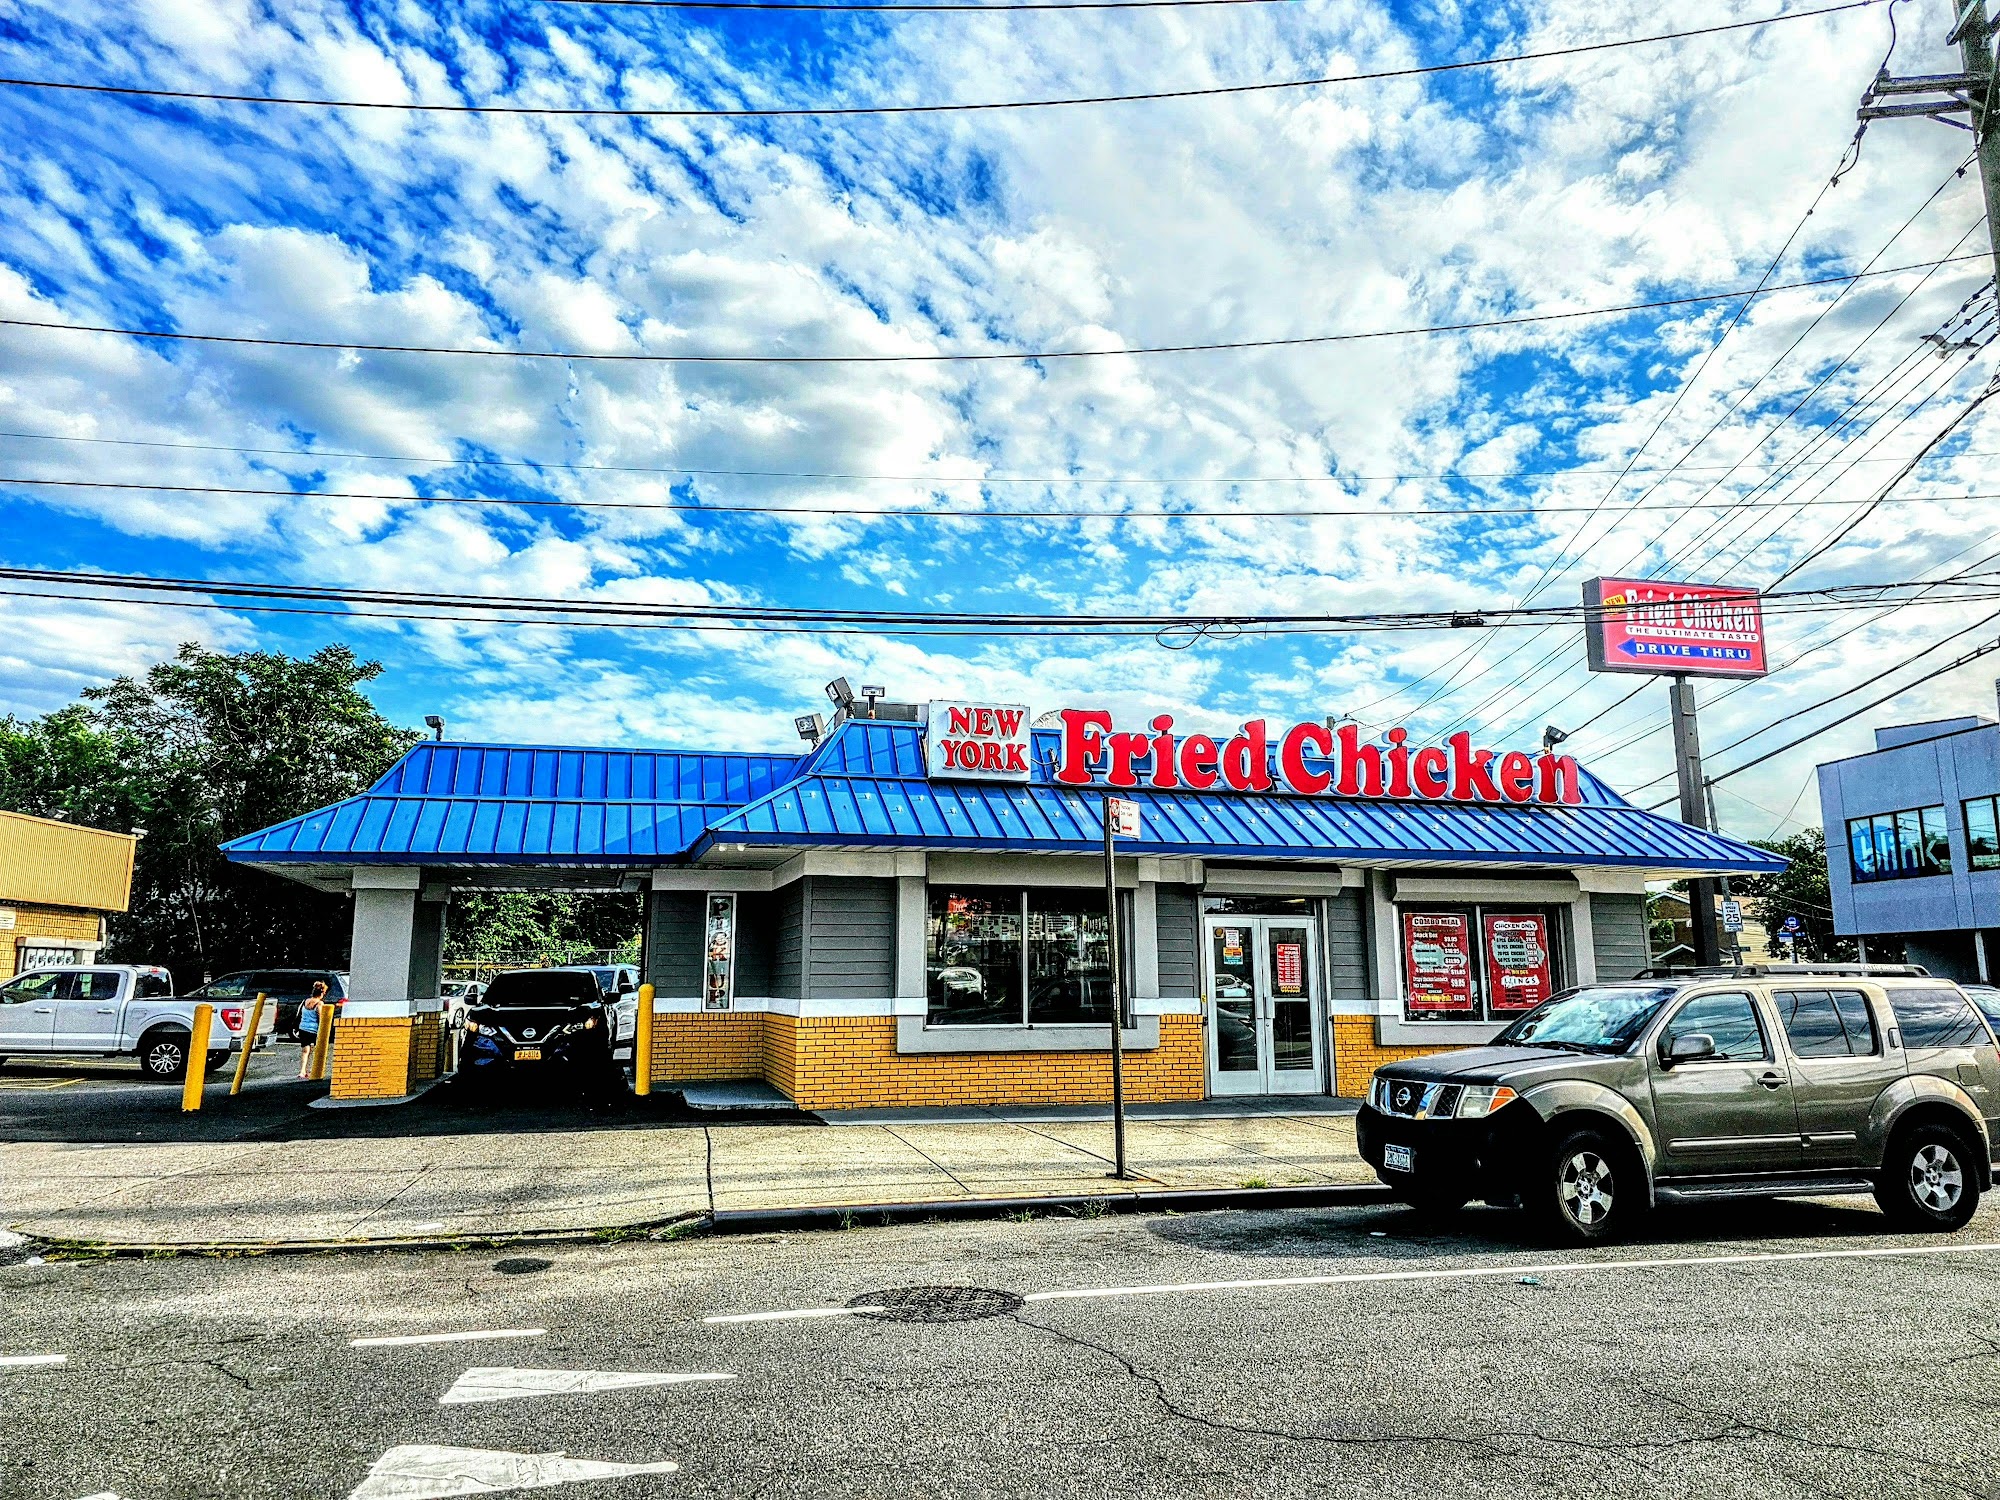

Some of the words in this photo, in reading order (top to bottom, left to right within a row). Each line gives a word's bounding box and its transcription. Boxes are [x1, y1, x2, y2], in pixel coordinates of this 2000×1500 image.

[1606, 596, 1622, 605] NEW
[1656, 628, 1714, 639] ULTIMATE
[1720, 632, 1757, 641] TASTE
[1635, 643, 1690, 656] DRIVE
[1700, 647, 1748, 659] THRU
[946, 706, 1024, 738] NEW
[941, 740, 1029, 772] YORK
[1056, 708, 1273, 792] Fried
[1276, 720, 1582, 805] Chicken
[1860, 831, 1941, 874] blink
[1725, 914, 1740, 922] 25
[1504, 977, 1536, 985] WINGS
